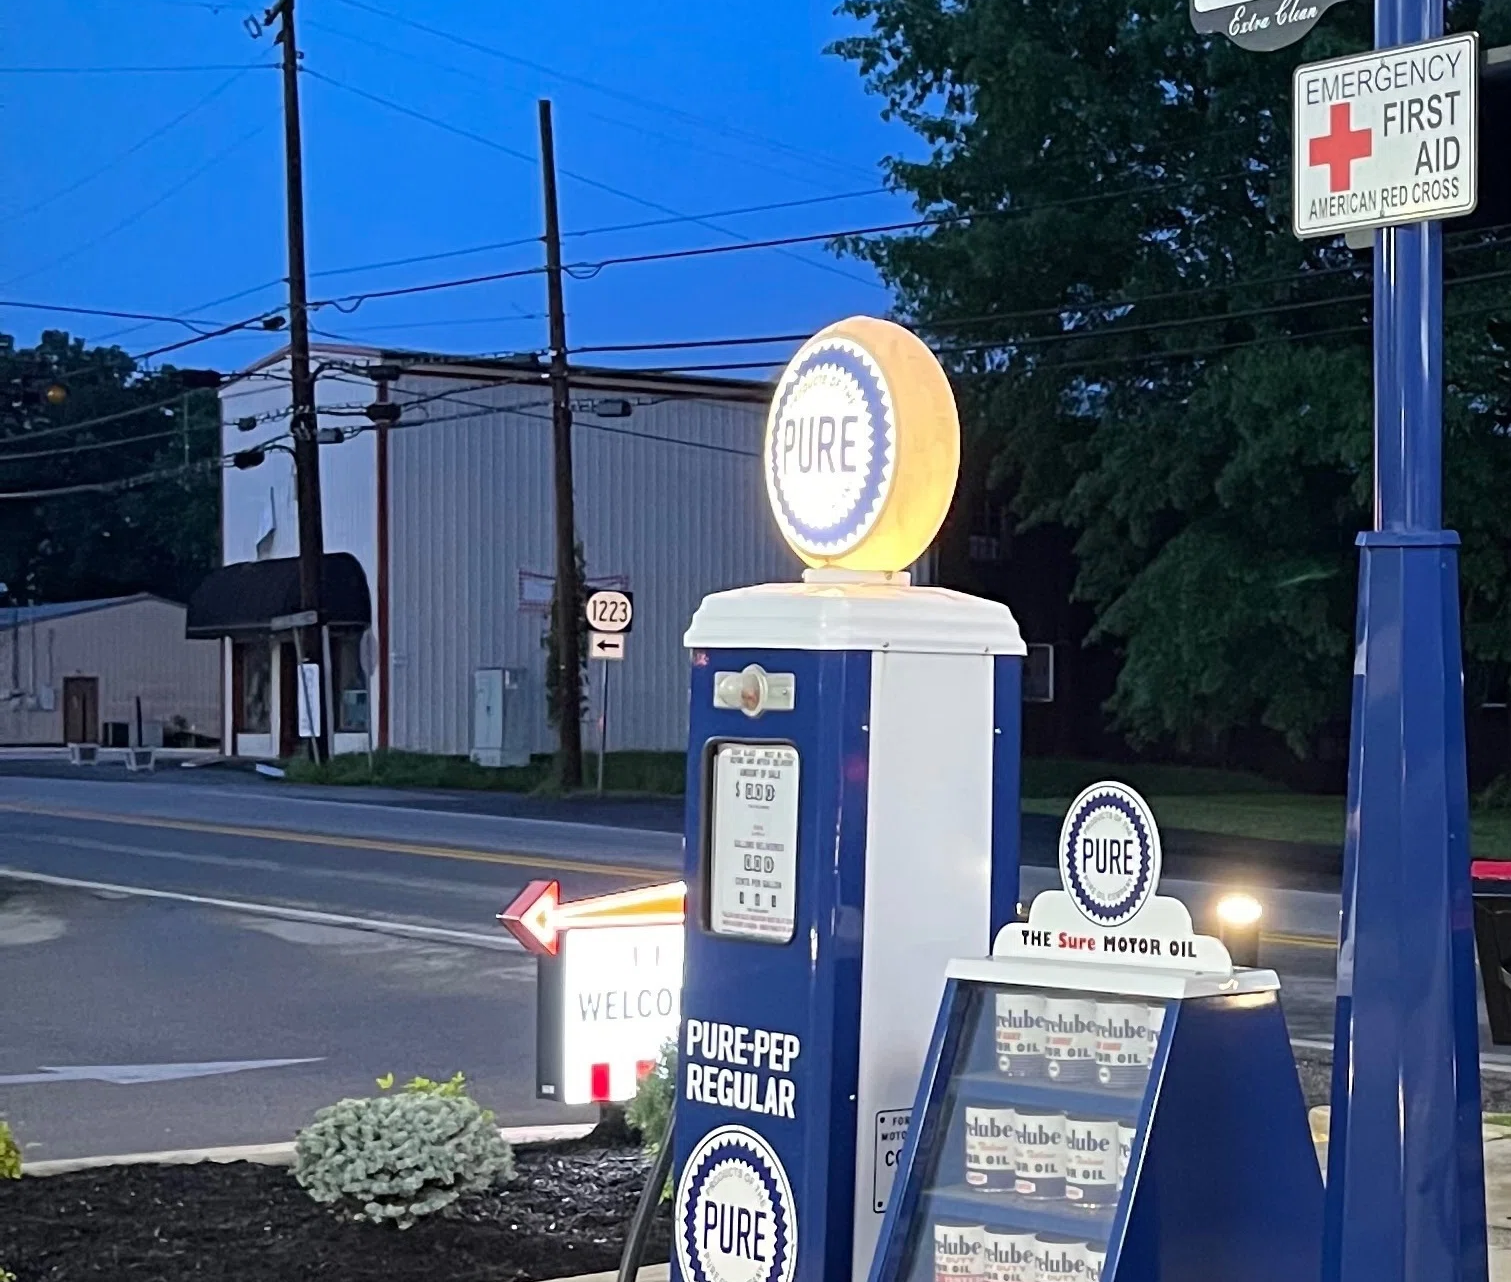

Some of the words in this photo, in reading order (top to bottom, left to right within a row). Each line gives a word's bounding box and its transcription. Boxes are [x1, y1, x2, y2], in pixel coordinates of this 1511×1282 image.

[1229, 5, 1271, 36] Extra
[1307, 50, 1462, 105] EMERGENCY
[1383, 90, 1461, 137] FIRST
[1415, 136, 1460, 176] AID
[1309, 189, 1376, 220] AMERICAN
[1381, 185, 1408, 208] RED
[1412, 177, 1459, 204] CROSS
[784, 415, 858, 474] PURE
[592, 600, 628, 622] 1223
[1083, 838, 1133, 875] PURE
[1021, 930, 1052, 947] THE
[1058, 932, 1096, 951] Sure
[1104, 936, 1161, 956] MOTOR
[1169, 941, 1197, 958] OIL
[579, 988, 673, 1021] WELCO
[686, 1019, 800, 1072] PURE-PEP
[1016, 1043, 1040, 1053] OIL
[1068, 1048, 1091, 1058] OIL
[1117, 1053, 1141, 1063] OIL
[686, 1062, 795, 1119] REGULAR
[881, 1131, 907, 1141] MOTO
[986, 1155, 1010, 1165] OIL
[1035, 1163, 1058, 1173] OIL
[1082, 1170, 1106, 1180] OIL
[704, 1200, 766, 1262] PURE
[952, 1265, 971, 1273] OIL
[1003, 1273, 1022, 1282] OIL
